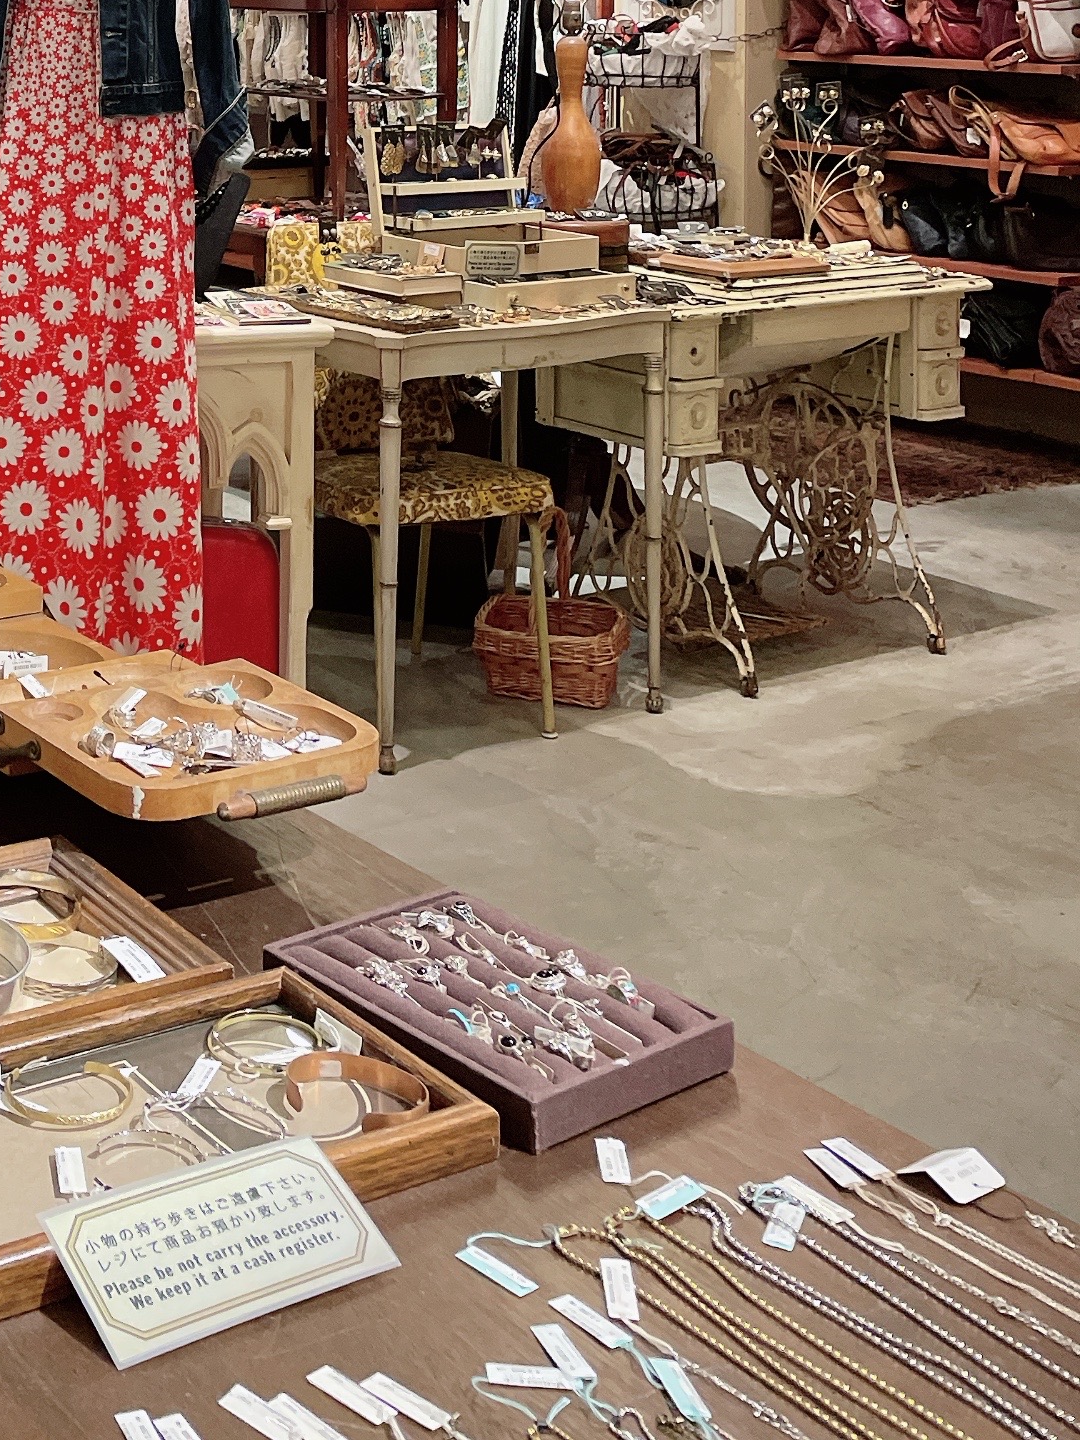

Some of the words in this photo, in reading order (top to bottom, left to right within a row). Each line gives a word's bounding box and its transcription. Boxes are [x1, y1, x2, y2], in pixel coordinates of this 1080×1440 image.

[85, 1172, 316, 1255] 小物の持ち歩きはご遠慮下さい。
[97, 1191, 326, 1274] レジにて商品お預かり致します。
[103, 1272, 154, 1299] Please
[157, 1264, 175, 1282] be
[177, 1254, 203, 1274] not
[206, 1240, 244, 1265] carry
[246, 1229, 271, 1251] the
[274, 1209, 344, 1241] accessory.
[129, 1291, 155, 1311] We
[158, 1281, 193, 1303] keep
[195, 1269, 209, 1287] it
[211, 1264, 229, 1282] at
[232, 1262, 241, 1276] a
[243, 1249, 278, 1271] cash
[279, 1230, 341, 1260] register.
